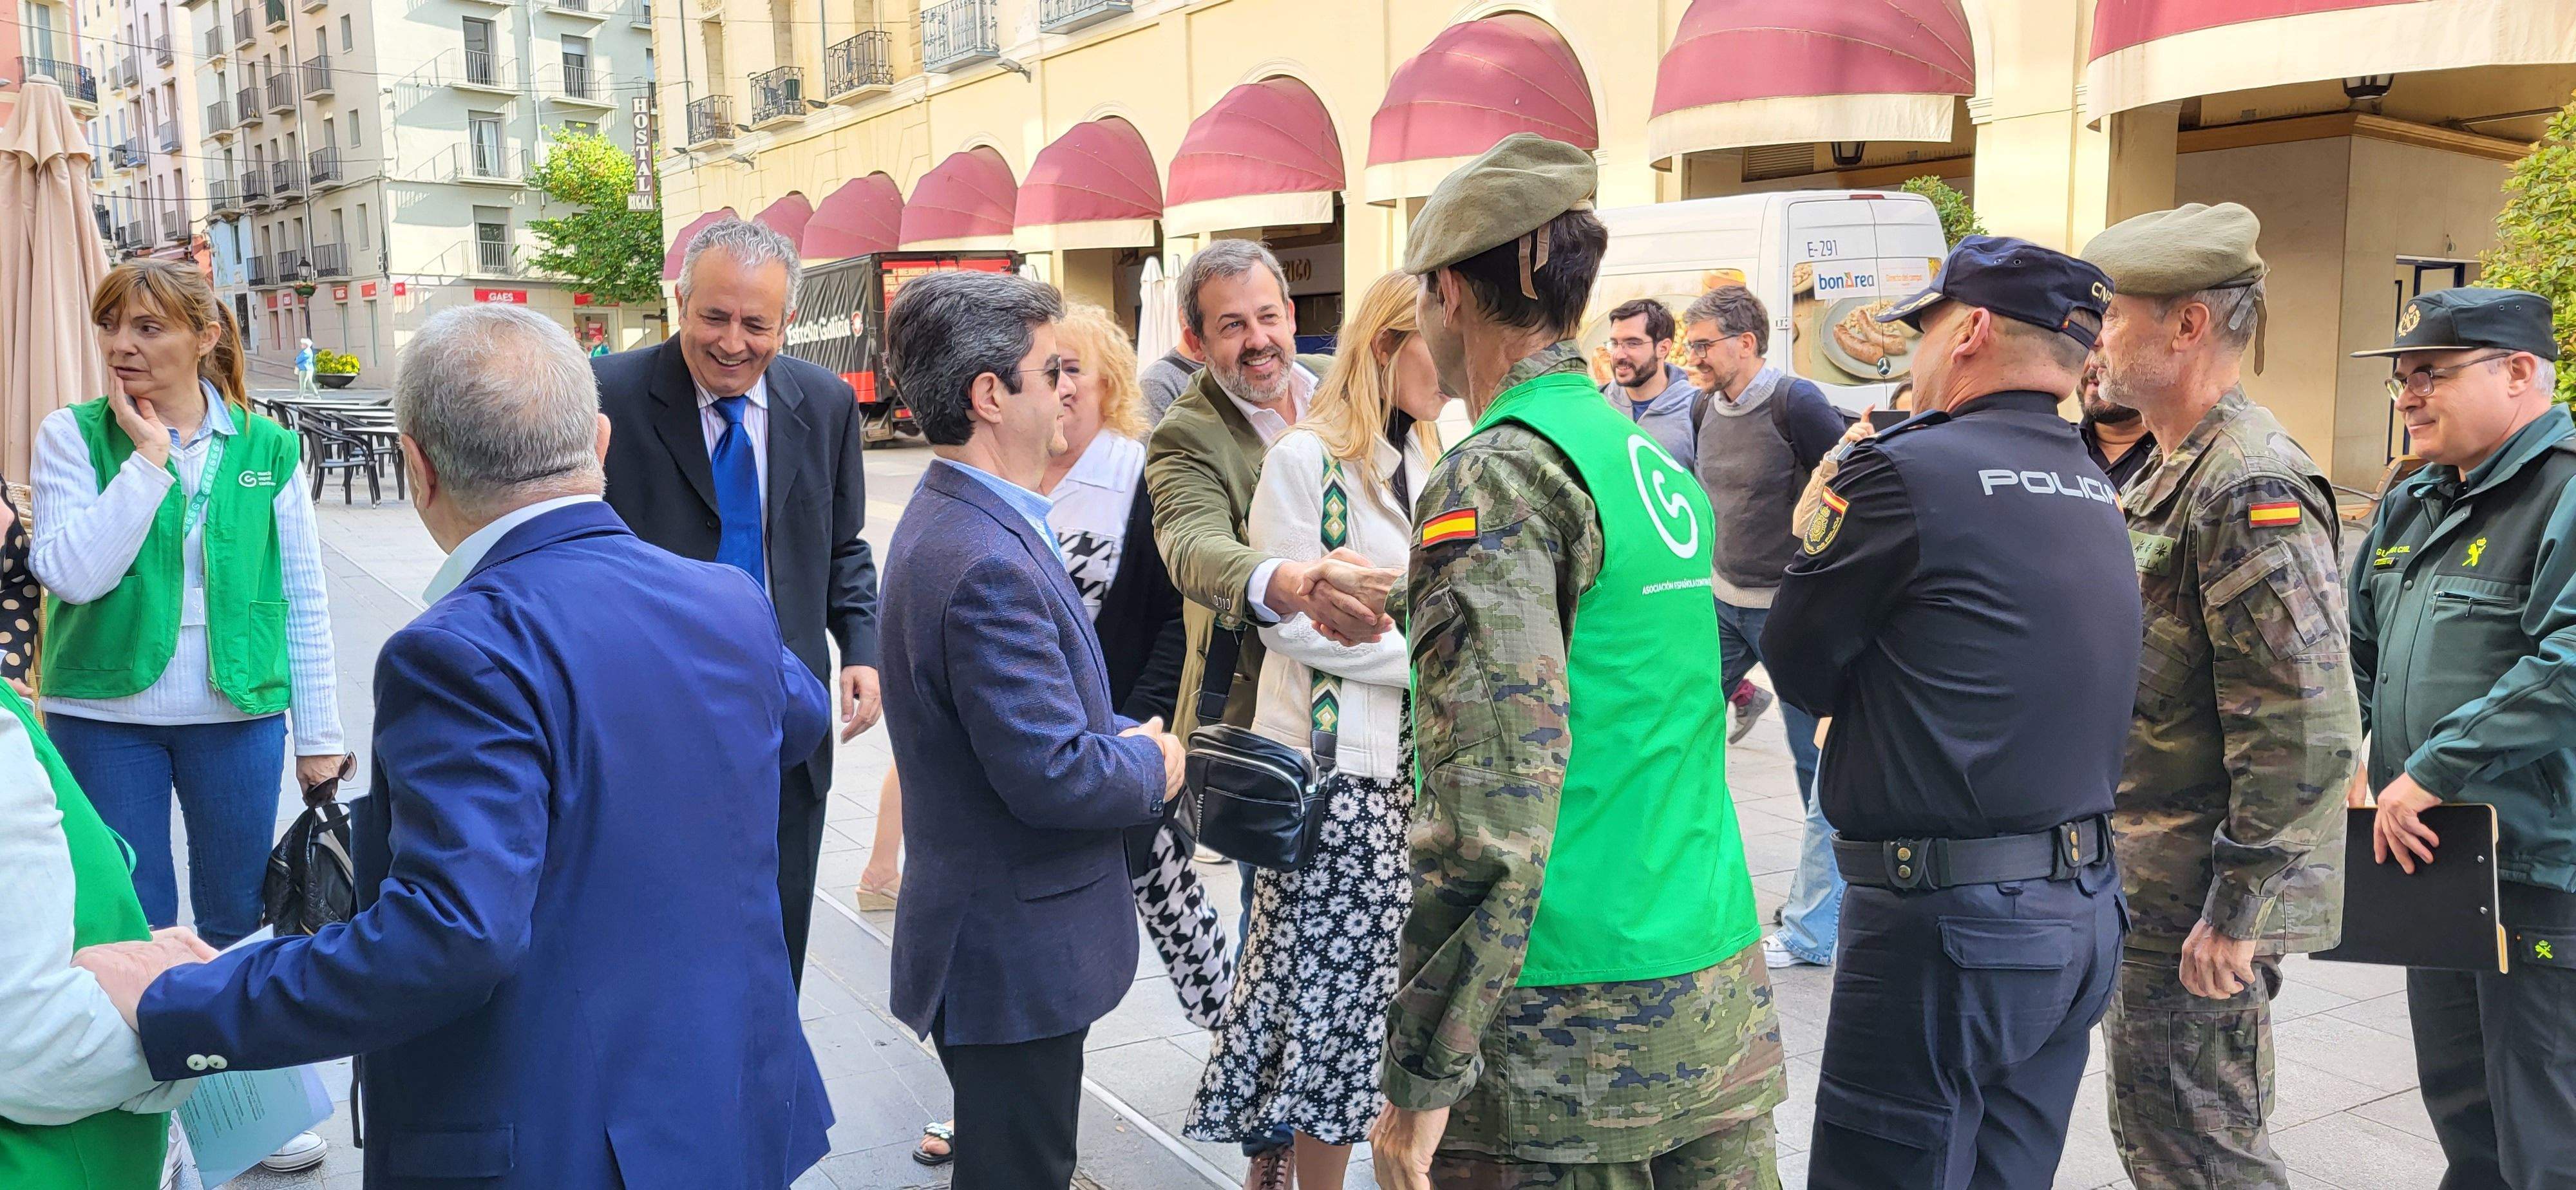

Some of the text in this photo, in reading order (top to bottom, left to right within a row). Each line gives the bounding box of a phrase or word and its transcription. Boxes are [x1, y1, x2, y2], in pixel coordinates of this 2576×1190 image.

[633, 99, 650, 192] HOSTAL
[489, 292, 513, 301] GAES
[2092, 281, 2112, 304] CNP
[786, 314, 851, 346] Estrella Galicia
[1978, 469, 2116, 505] POLICIA
[1642, 580, 1674, 595] ASOCIACIÓN
[1674, 578, 1695, 590] ESPAÑOLA
